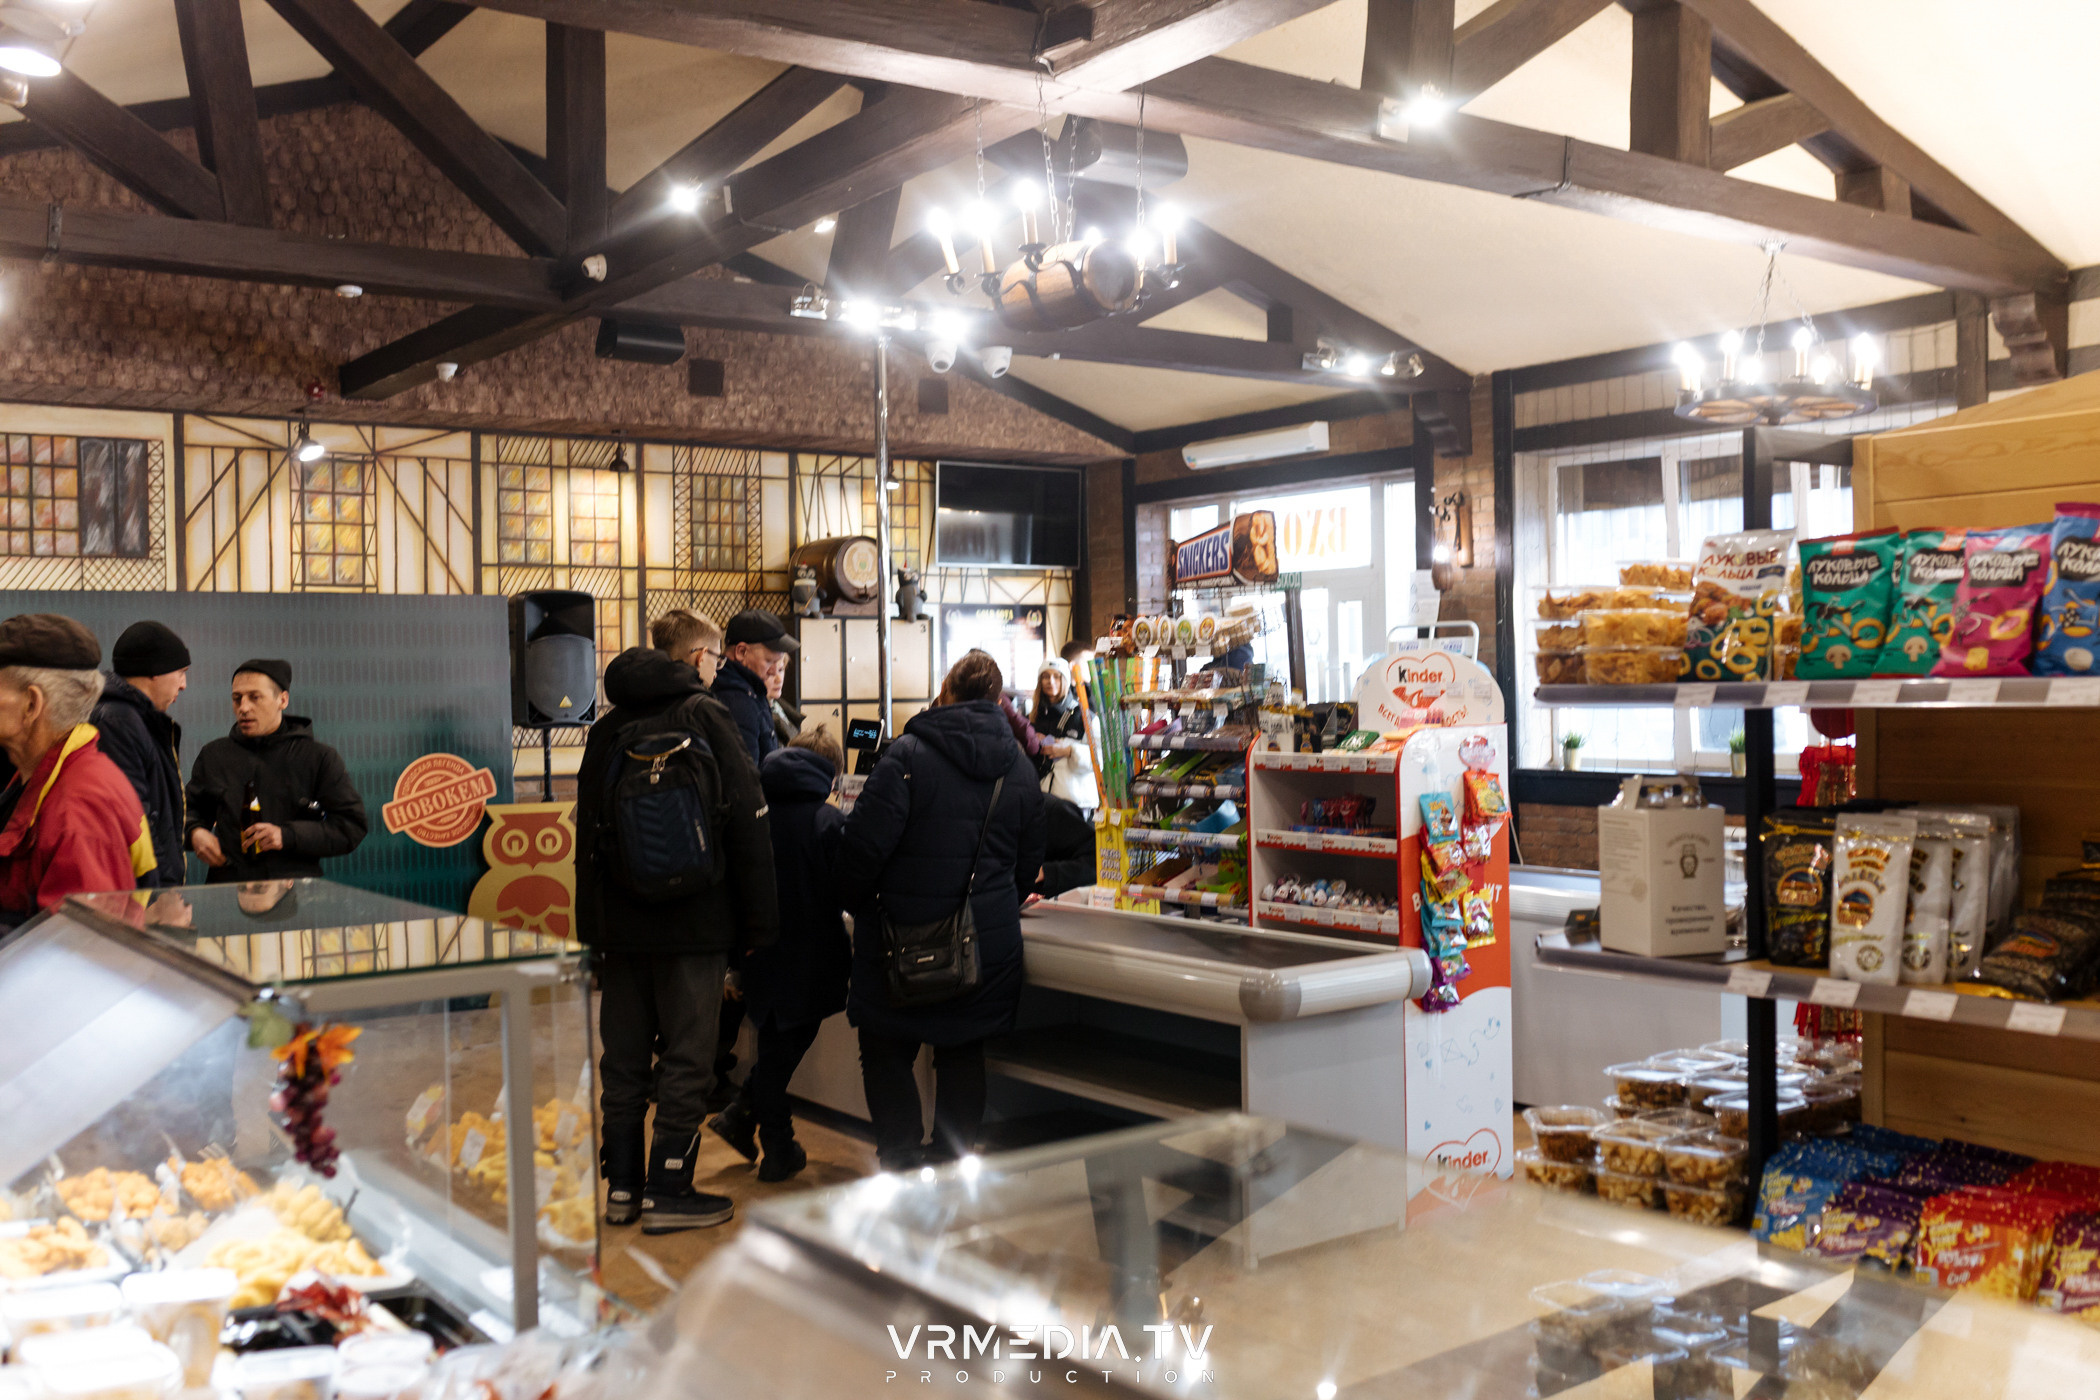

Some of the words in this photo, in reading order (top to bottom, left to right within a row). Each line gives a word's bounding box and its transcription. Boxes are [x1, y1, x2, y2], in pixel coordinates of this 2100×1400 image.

[1177, 529, 1230, 579] SNICKERS
[1969, 553, 2038, 568] ЛУКОВЫЕ
[1808, 556, 1879, 574] ЛУКОВЫЕ
[1813, 571, 1869, 585] КОЛЬЦА
[1970, 567, 2023, 581] КОЛЬЦА
[1398, 666, 1443, 683] kinder
[433, 760, 465, 774] ЛЕГЕНДА
[391, 776, 488, 826] НОВОКЕМ
